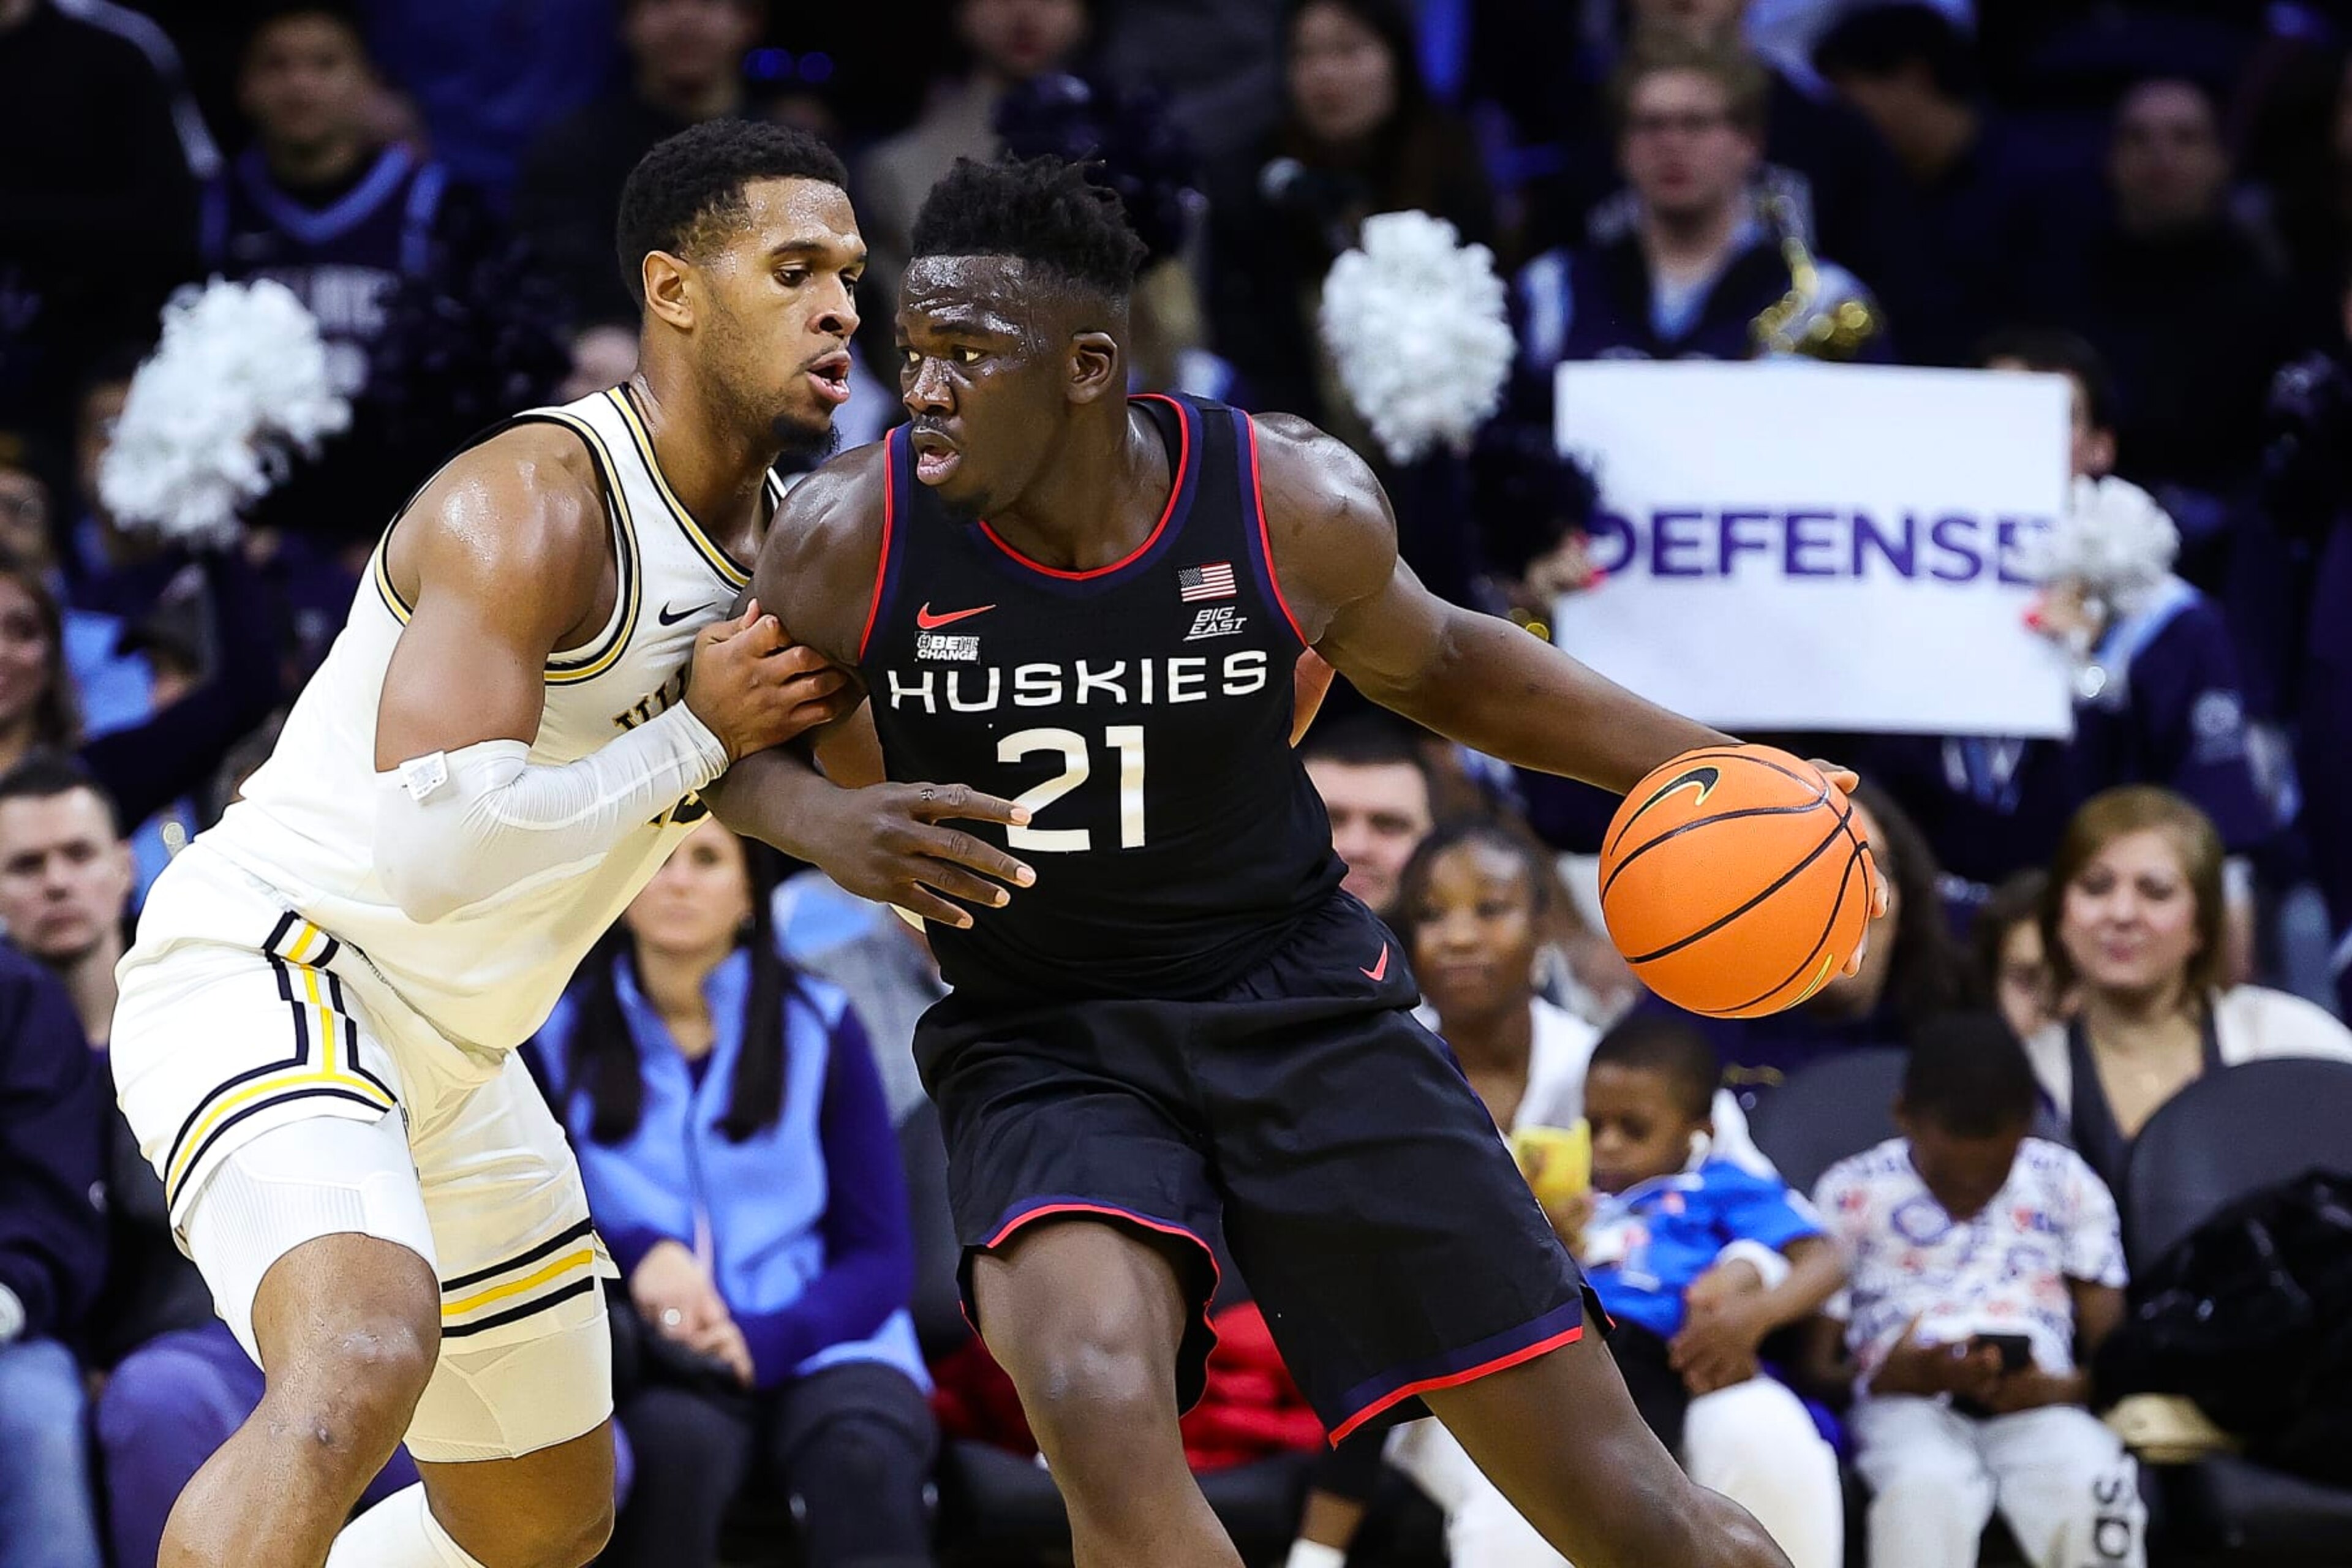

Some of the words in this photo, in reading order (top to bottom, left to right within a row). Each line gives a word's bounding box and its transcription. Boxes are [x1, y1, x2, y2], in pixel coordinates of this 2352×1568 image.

[1195, 606, 1235, 623] BIG
[1189, 617, 1248, 635] EAST
[917, 649, 978, 661] CHANGE
[888, 650, 1267, 714] HUSKIES
[997, 725, 1145, 852] 21
